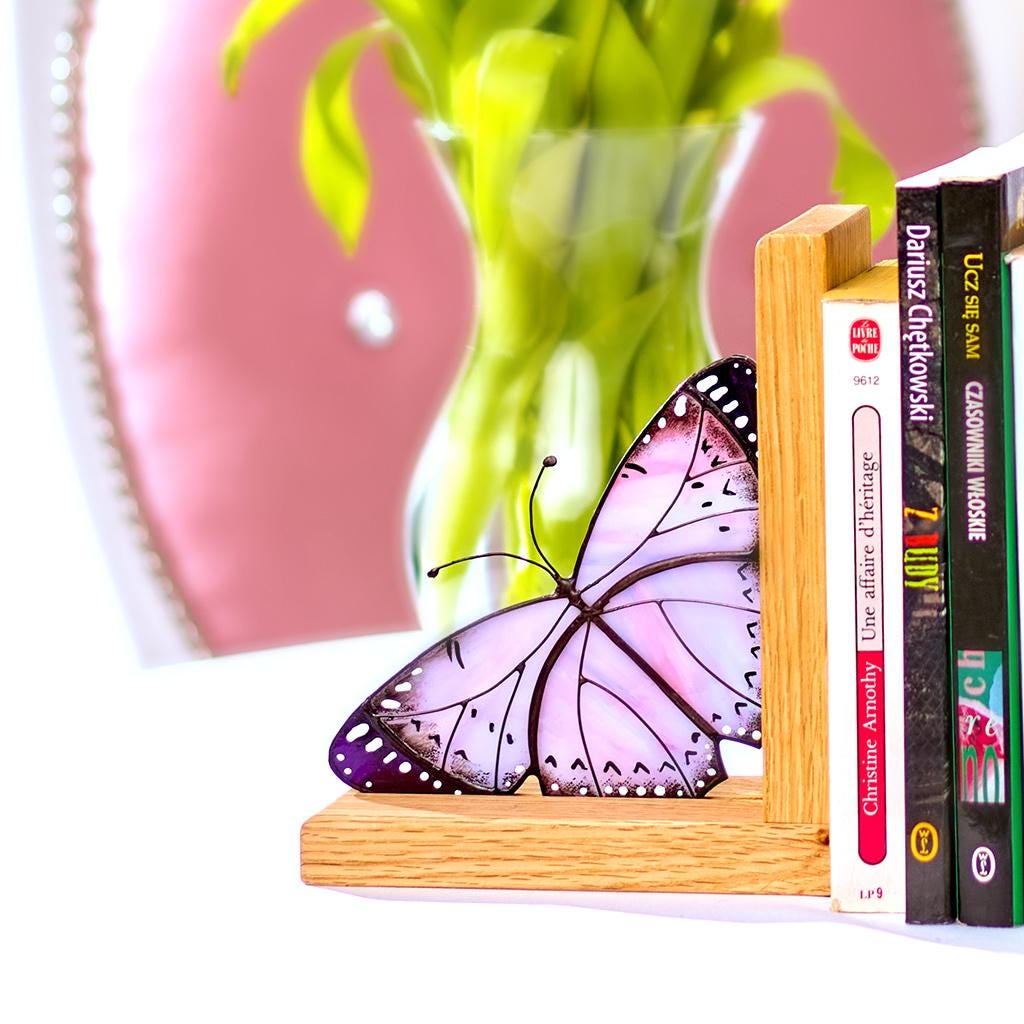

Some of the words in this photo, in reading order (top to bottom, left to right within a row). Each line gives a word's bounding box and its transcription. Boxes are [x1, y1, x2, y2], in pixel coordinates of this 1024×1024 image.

[906, 225, 931, 299] Dariusz
[963, 252, 983, 291] UCZ
[962, 295, 980, 319] SIĘ
[852, 328, 878, 338] LIVRE
[852, 343, 879, 354] POCHE
[966, 323, 980, 359] SAM
[853, 375, 880, 386] 9612
[903, 304, 934, 421] Chętkowski
[965, 381, 985, 473] CZASOWNIKI
[858, 451, 879, 538] d'héritage
[904, 507, 938, 521] Z
[967, 476, 987, 541] WŁOSKIE
[859, 544, 876, 599] affaire
[861, 606, 876, 642] Une
[861, 661, 882, 732] Arnothy
[862, 739, 878, 816] Christine
